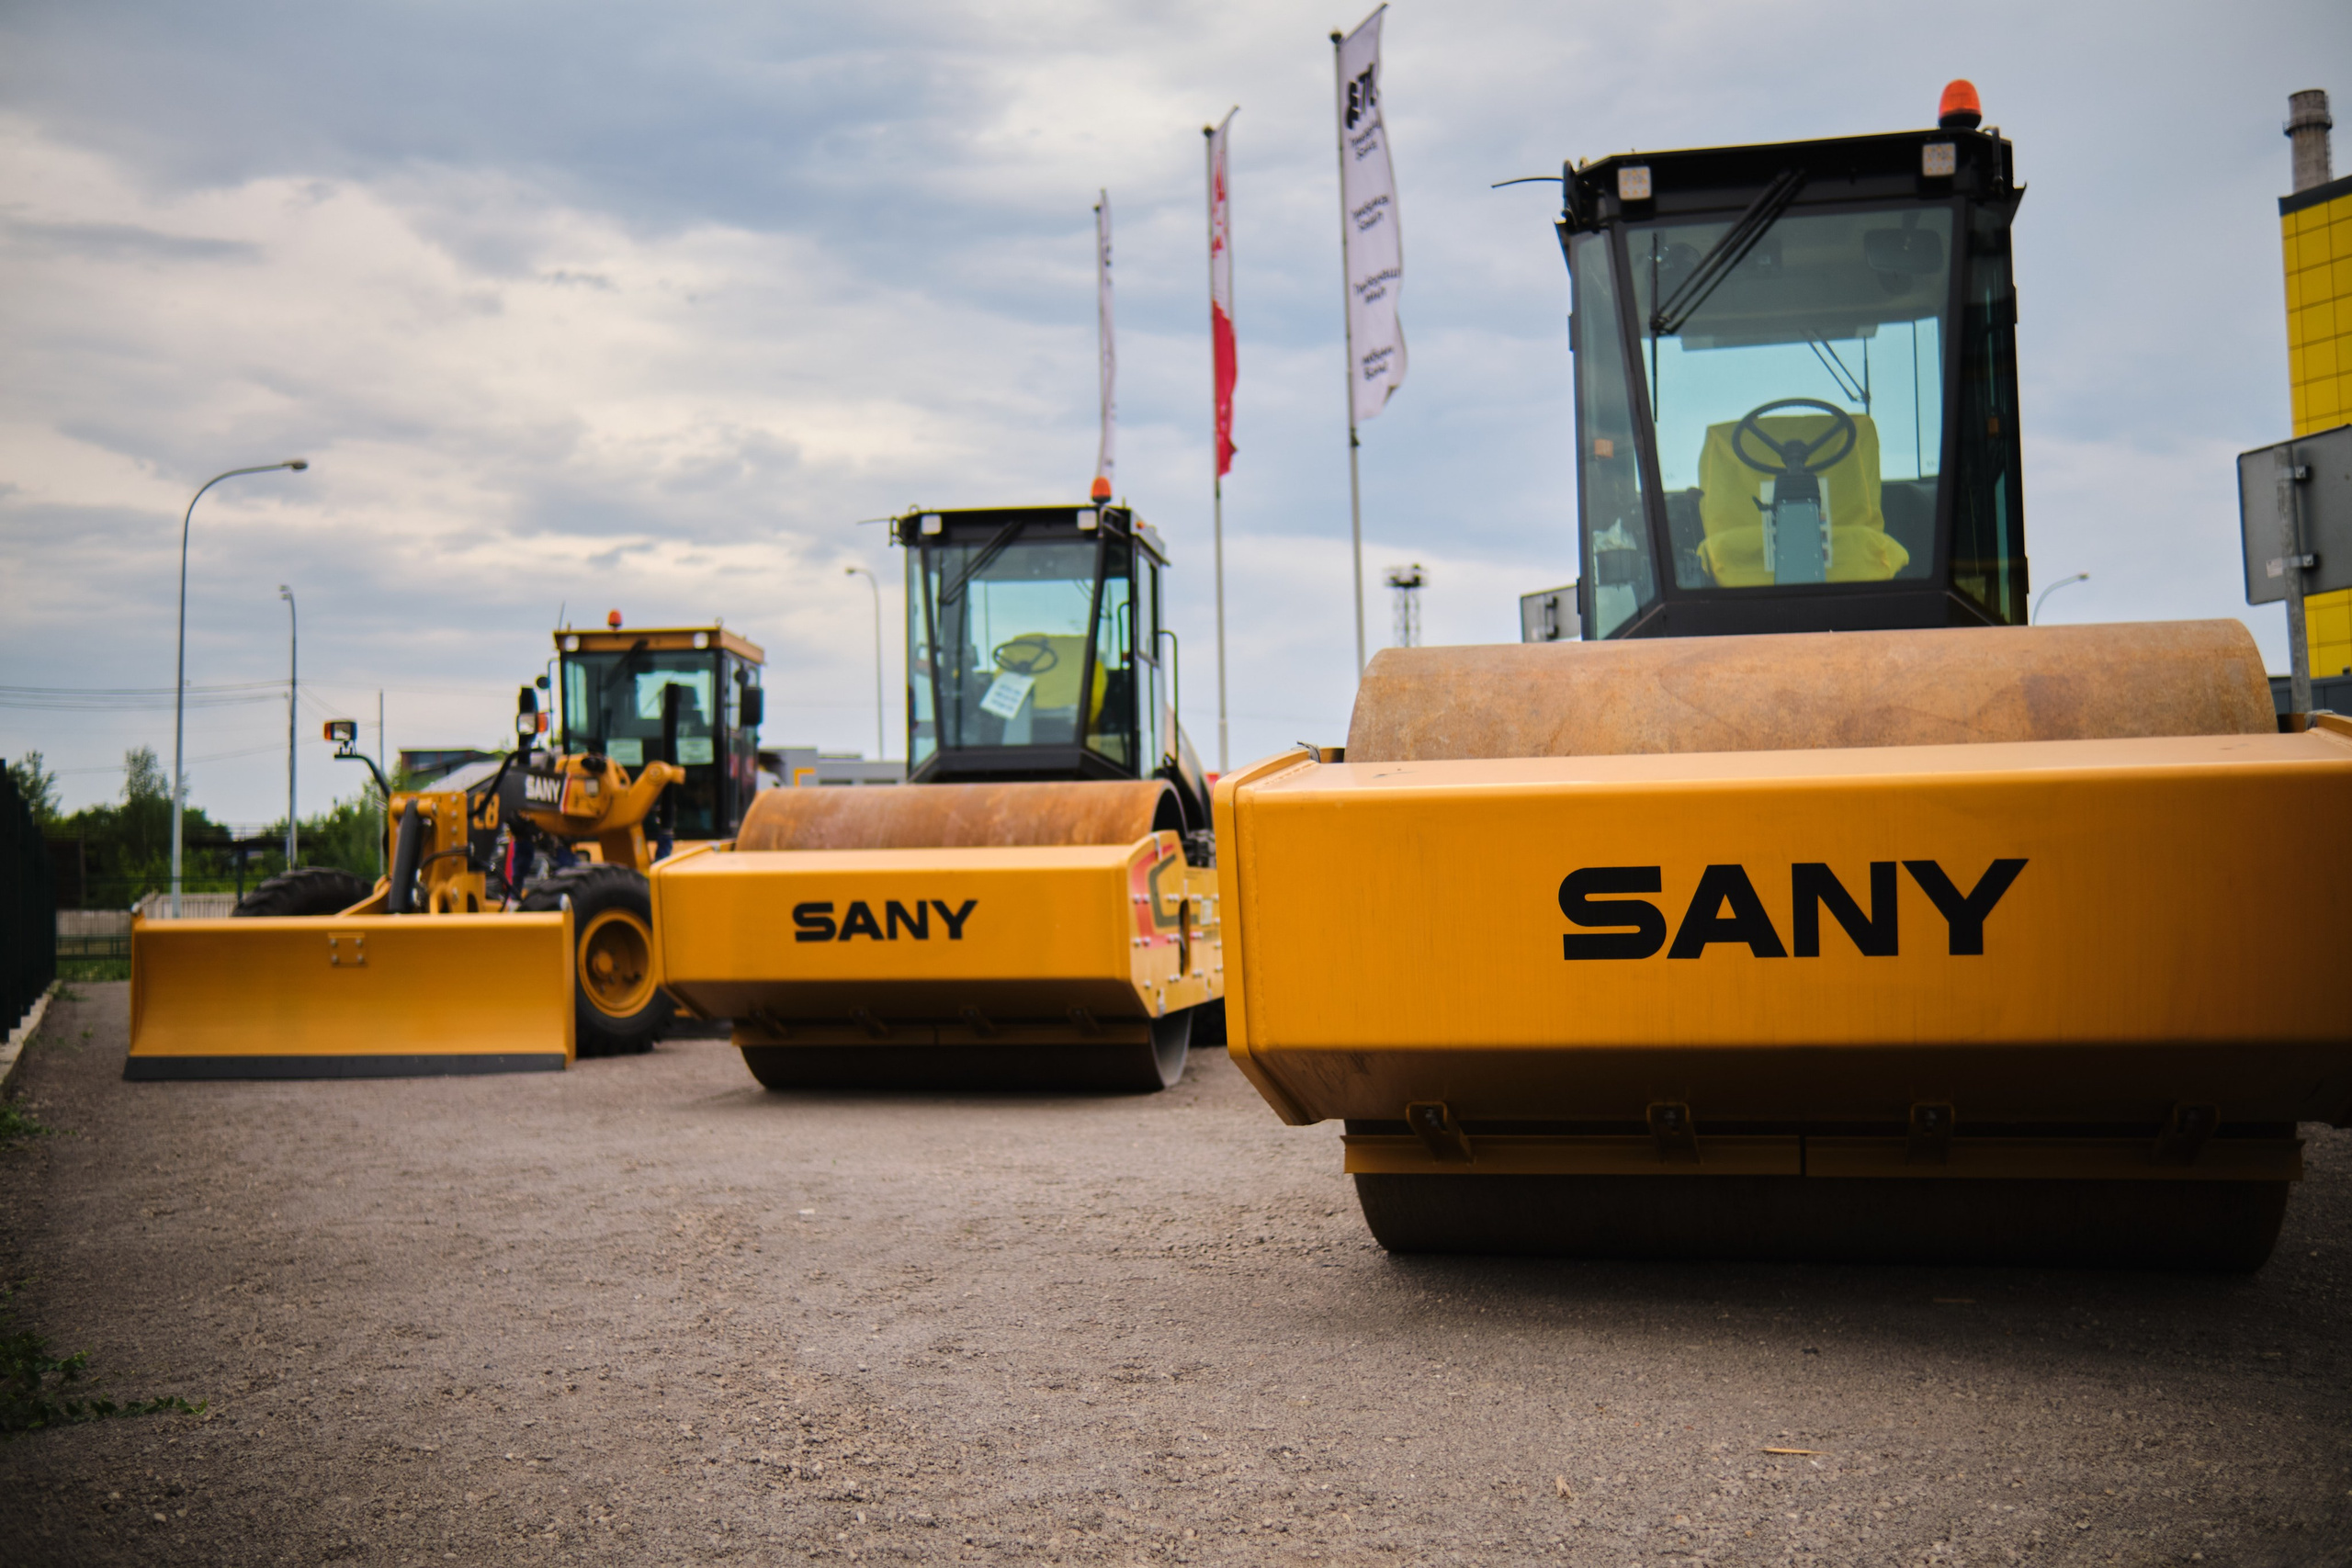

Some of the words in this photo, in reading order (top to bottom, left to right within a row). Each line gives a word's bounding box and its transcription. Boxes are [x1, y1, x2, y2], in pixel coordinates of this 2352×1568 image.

[525, 774, 560, 804] SANY
[792, 899, 978, 942] SANY
[1558, 859, 2030, 961] SANY
